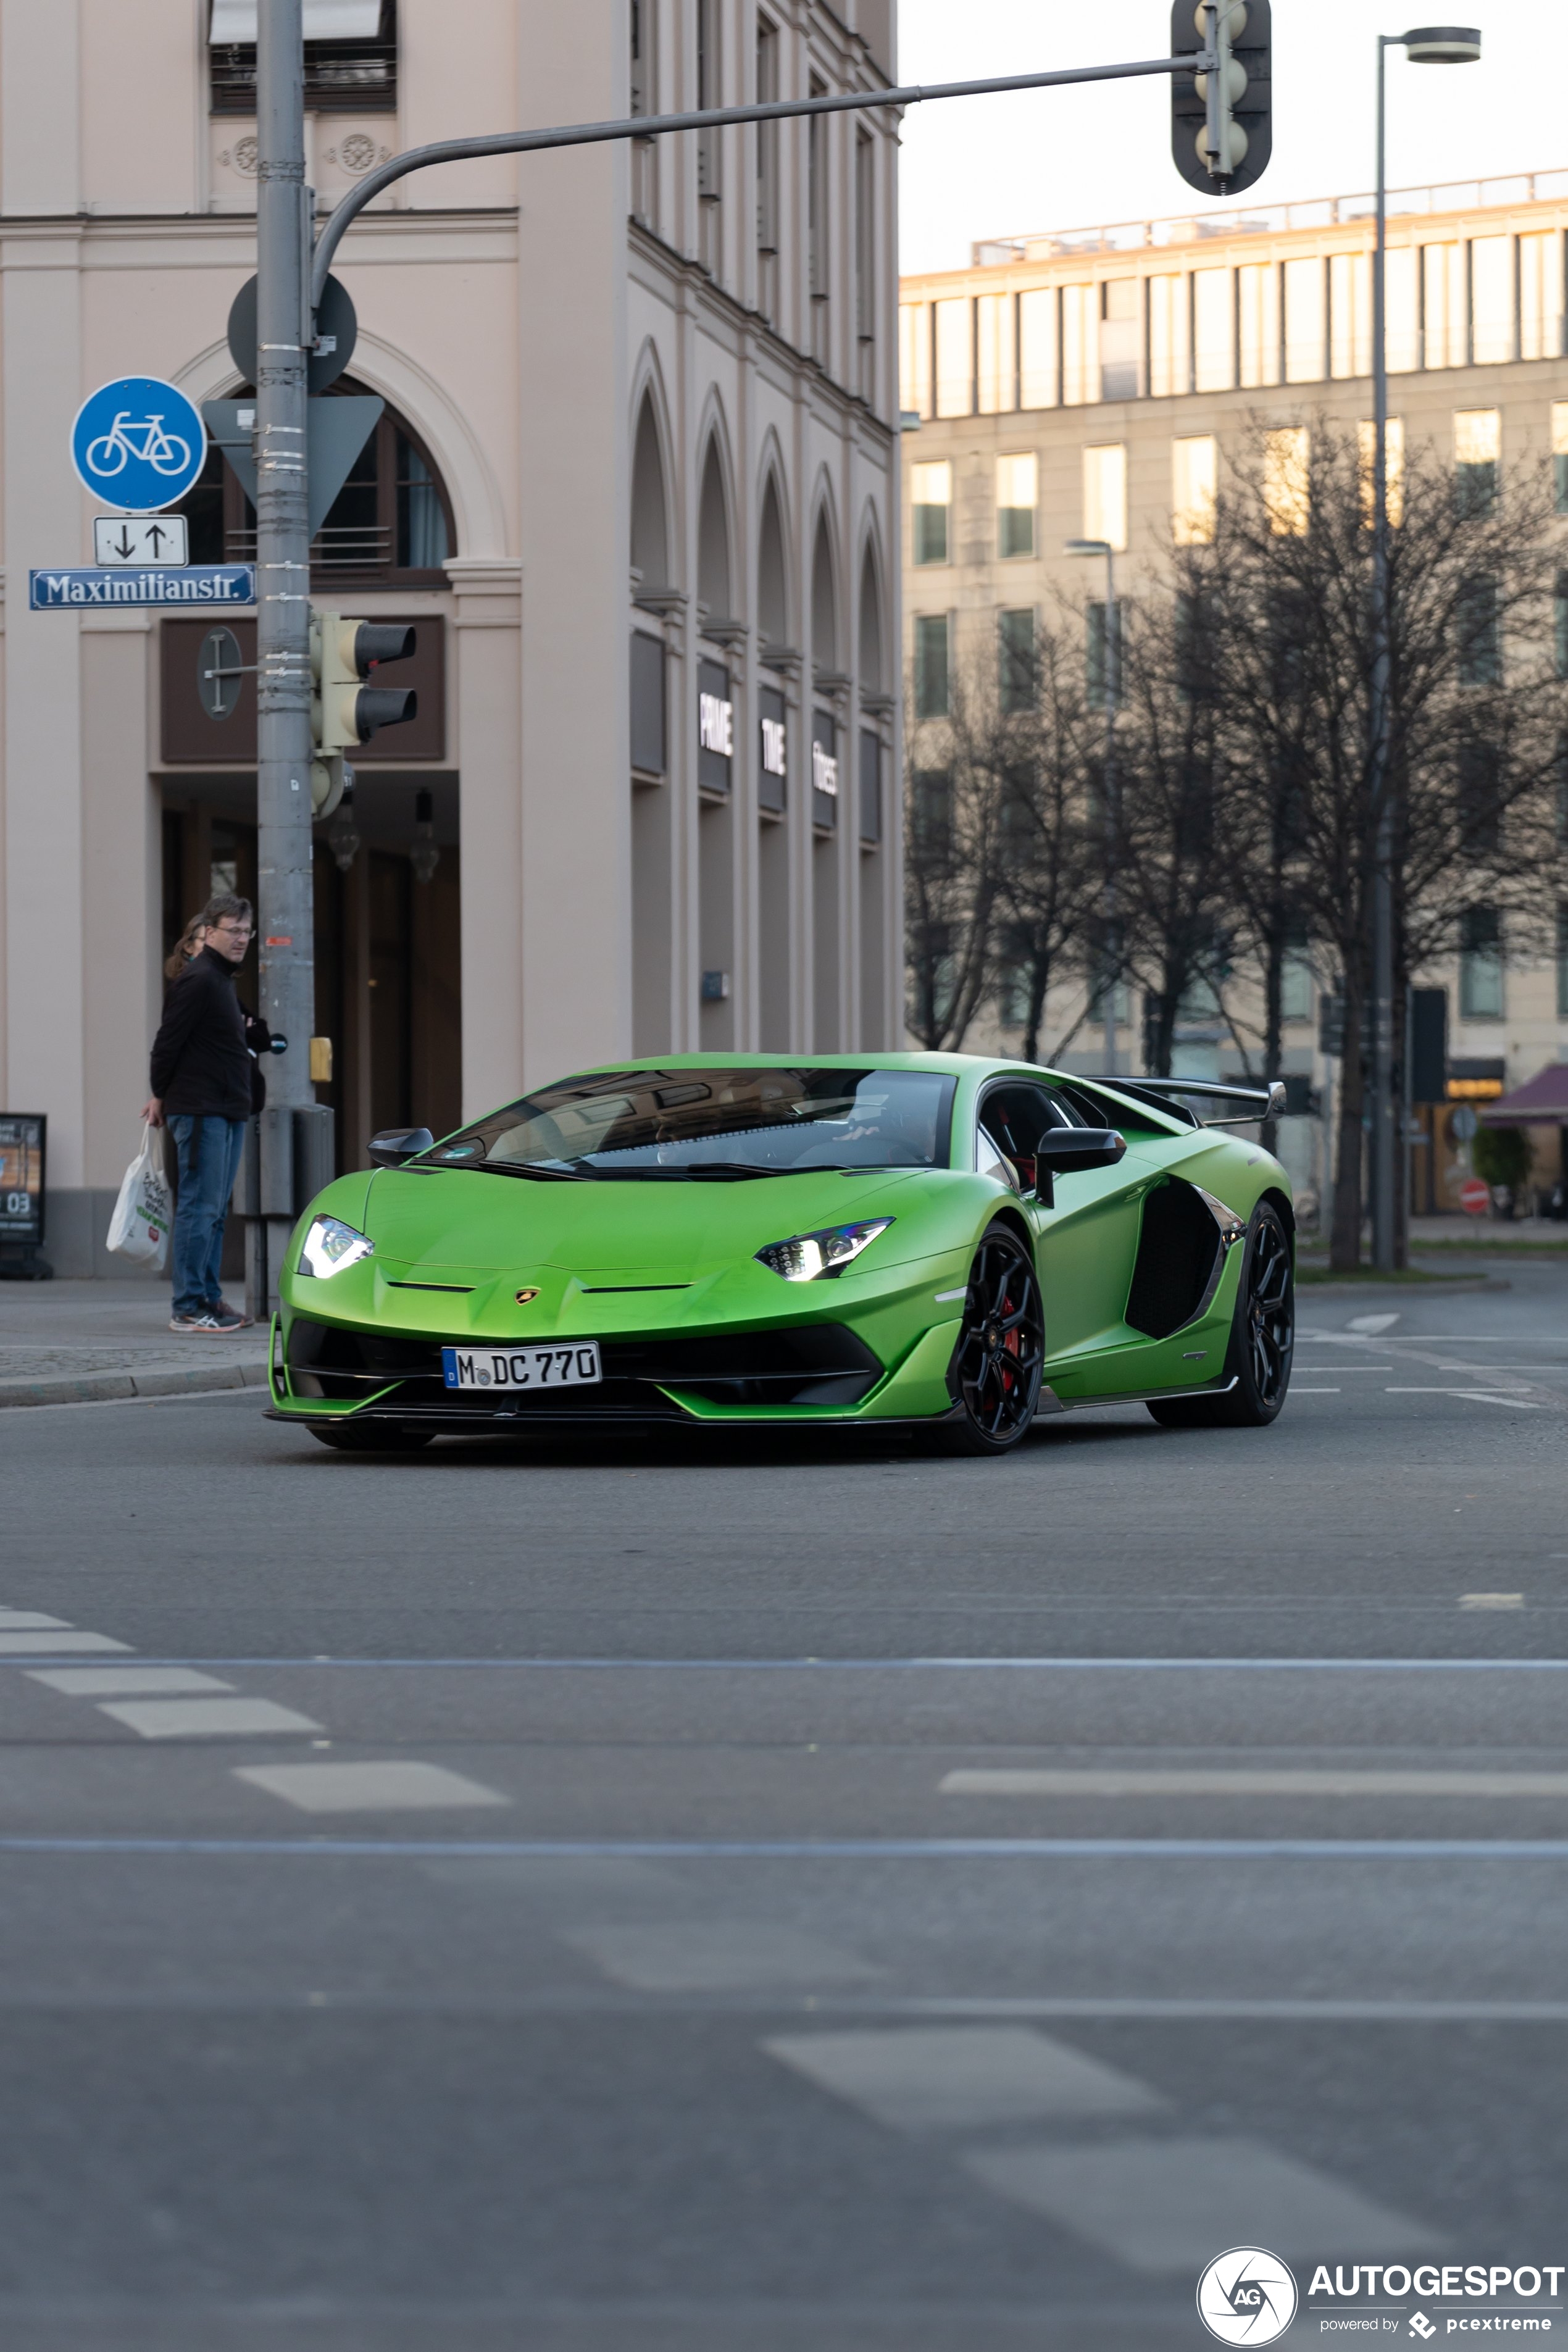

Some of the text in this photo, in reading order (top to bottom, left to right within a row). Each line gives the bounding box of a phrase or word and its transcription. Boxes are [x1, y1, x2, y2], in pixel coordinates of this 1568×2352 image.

[46, 573, 240, 603] Maximilianstr.
[457, 1348, 596, 1385] M DC 770
